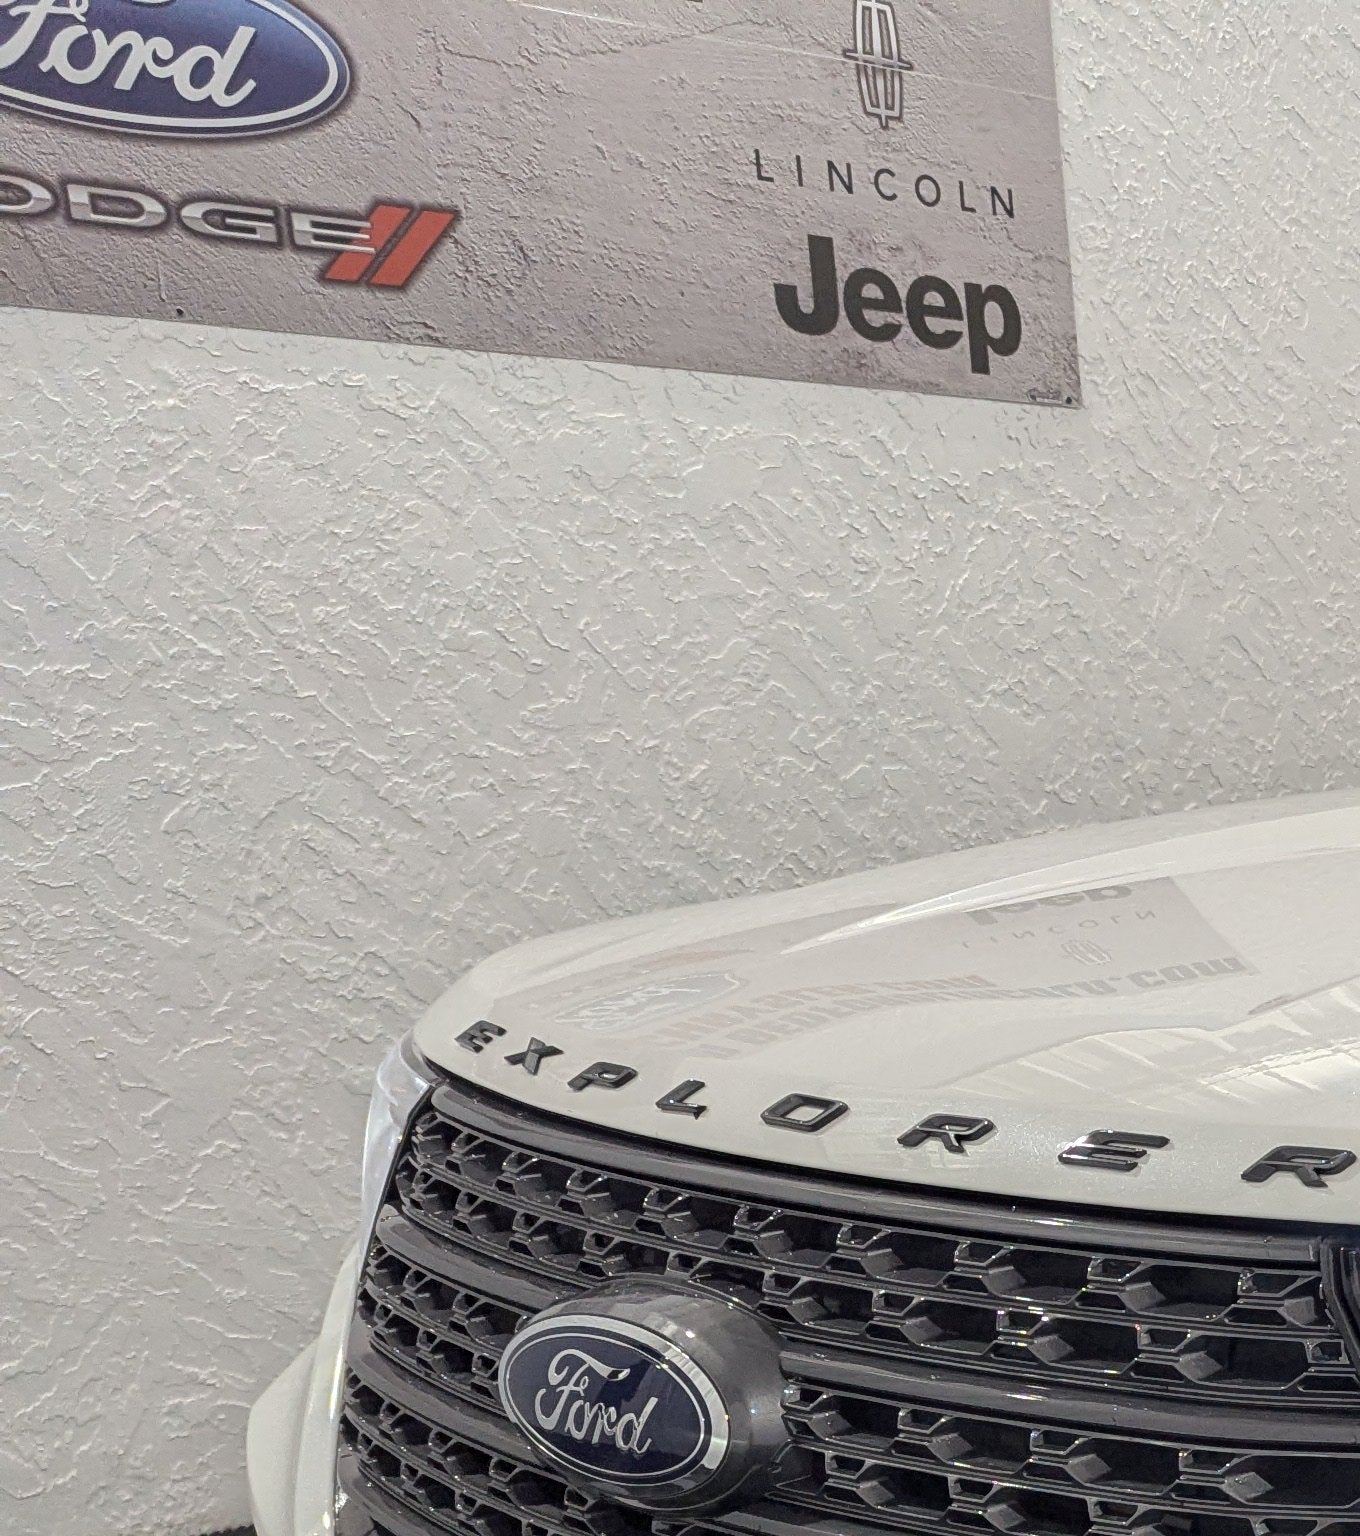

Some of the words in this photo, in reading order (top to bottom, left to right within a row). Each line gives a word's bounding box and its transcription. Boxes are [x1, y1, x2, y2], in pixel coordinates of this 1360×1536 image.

[754, 149, 1015, 219] LINCOLN
[773, 234, 1022, 376] Jeep
[455, 1020, 1358, 1188] EXPLORER
[535, 1348, 659, 1454] Ford
